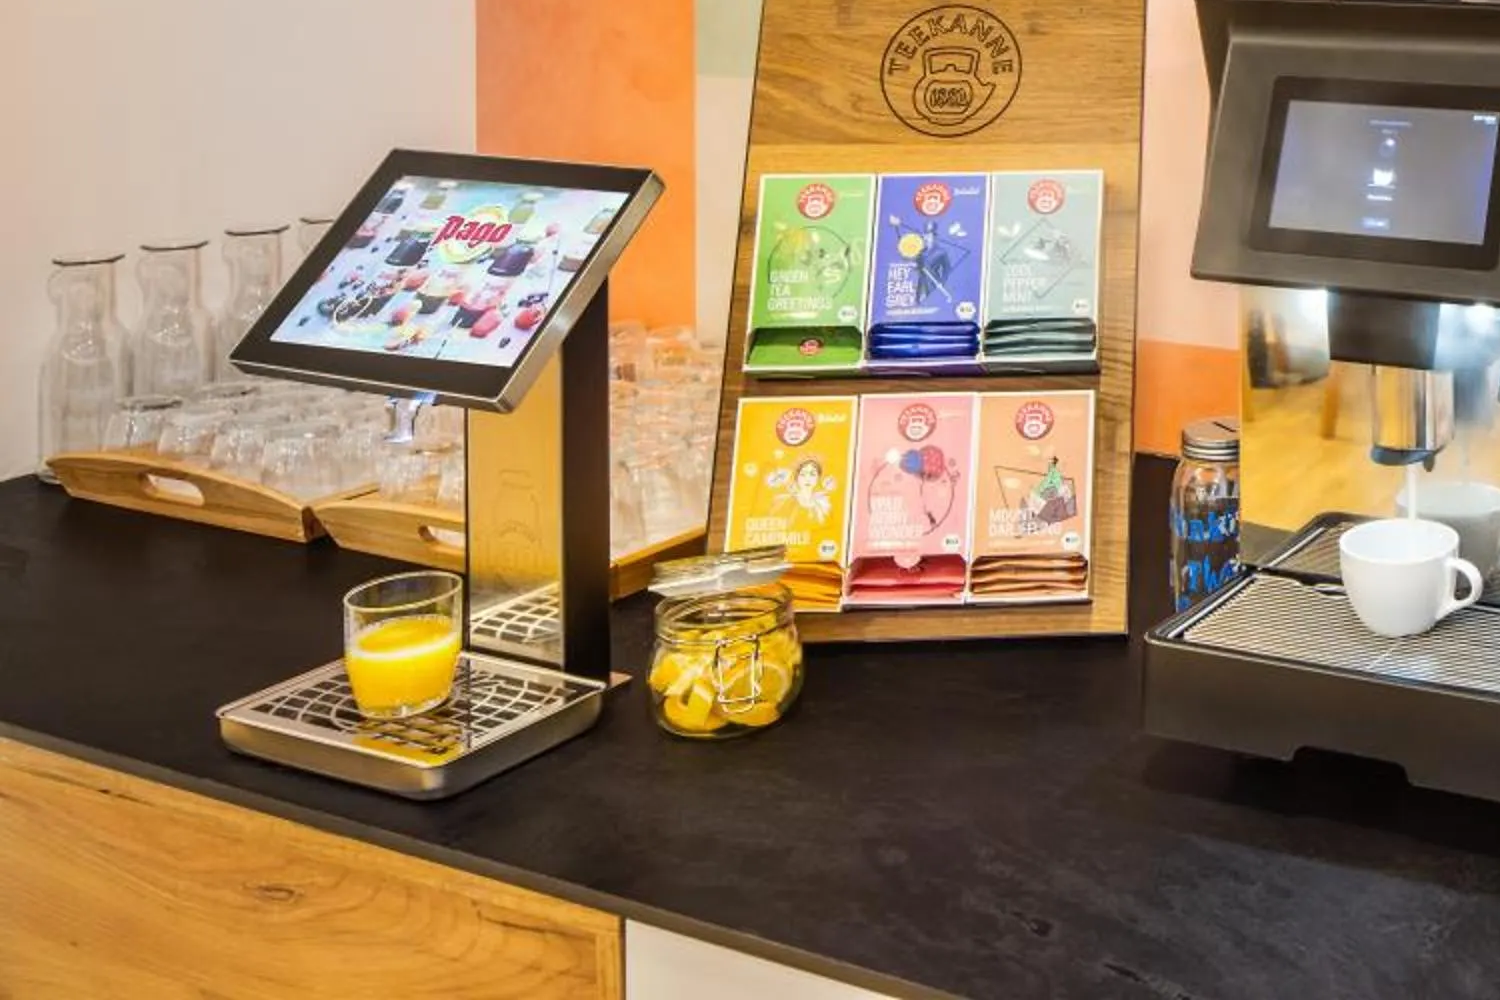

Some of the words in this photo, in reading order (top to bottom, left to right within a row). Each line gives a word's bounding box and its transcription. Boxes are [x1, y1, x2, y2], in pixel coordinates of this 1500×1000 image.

[887, 13, 1014, 75] TEEKANNE
[929, 87, 969, 108] 1882
[770, 269, 809, 283] GREEN
[770, 283, 791, 296] TEA
[745, 517, 787, 531] QUEEN
[744, 531, 812, 546] CAMOMILE
